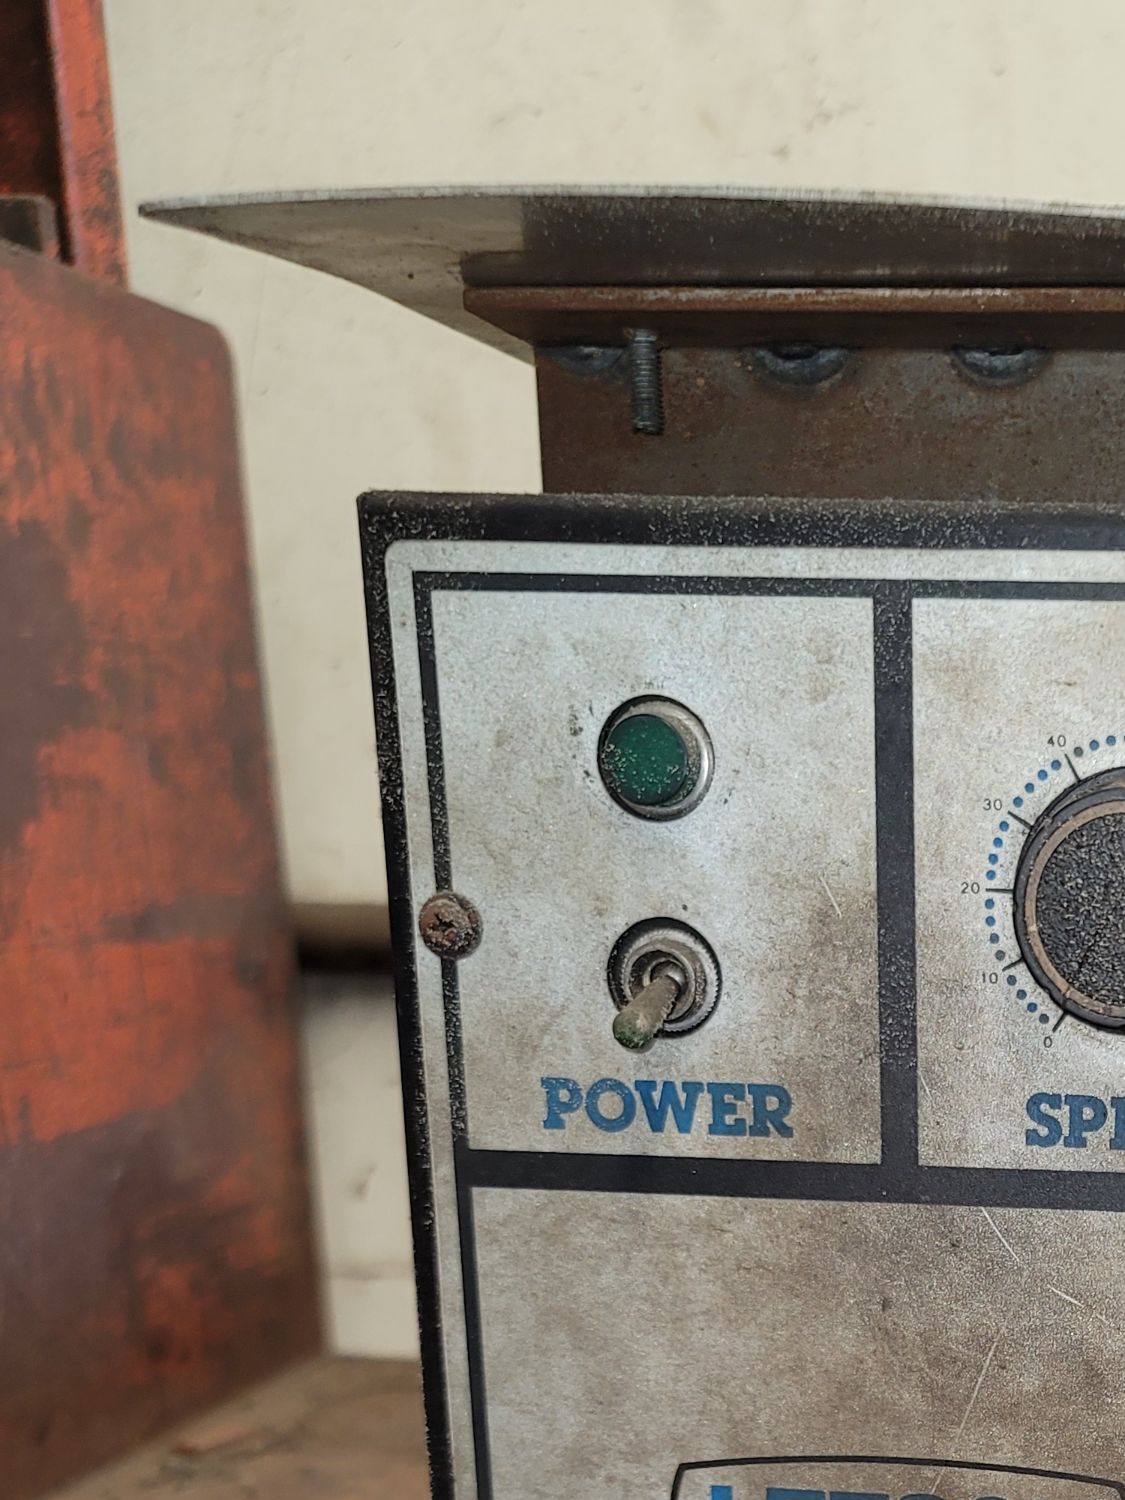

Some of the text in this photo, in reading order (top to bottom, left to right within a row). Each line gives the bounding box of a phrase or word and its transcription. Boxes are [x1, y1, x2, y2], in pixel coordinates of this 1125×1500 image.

[1047, 735, 1067, 748] 40
[982, 799, 1003, 811] 30
[961, 883, 980, 895] 20
[982, 972, 998, 985] 10
[1043, 1036, 1053, 1049] 0
[540, 1076, 794, 1138] POWER
